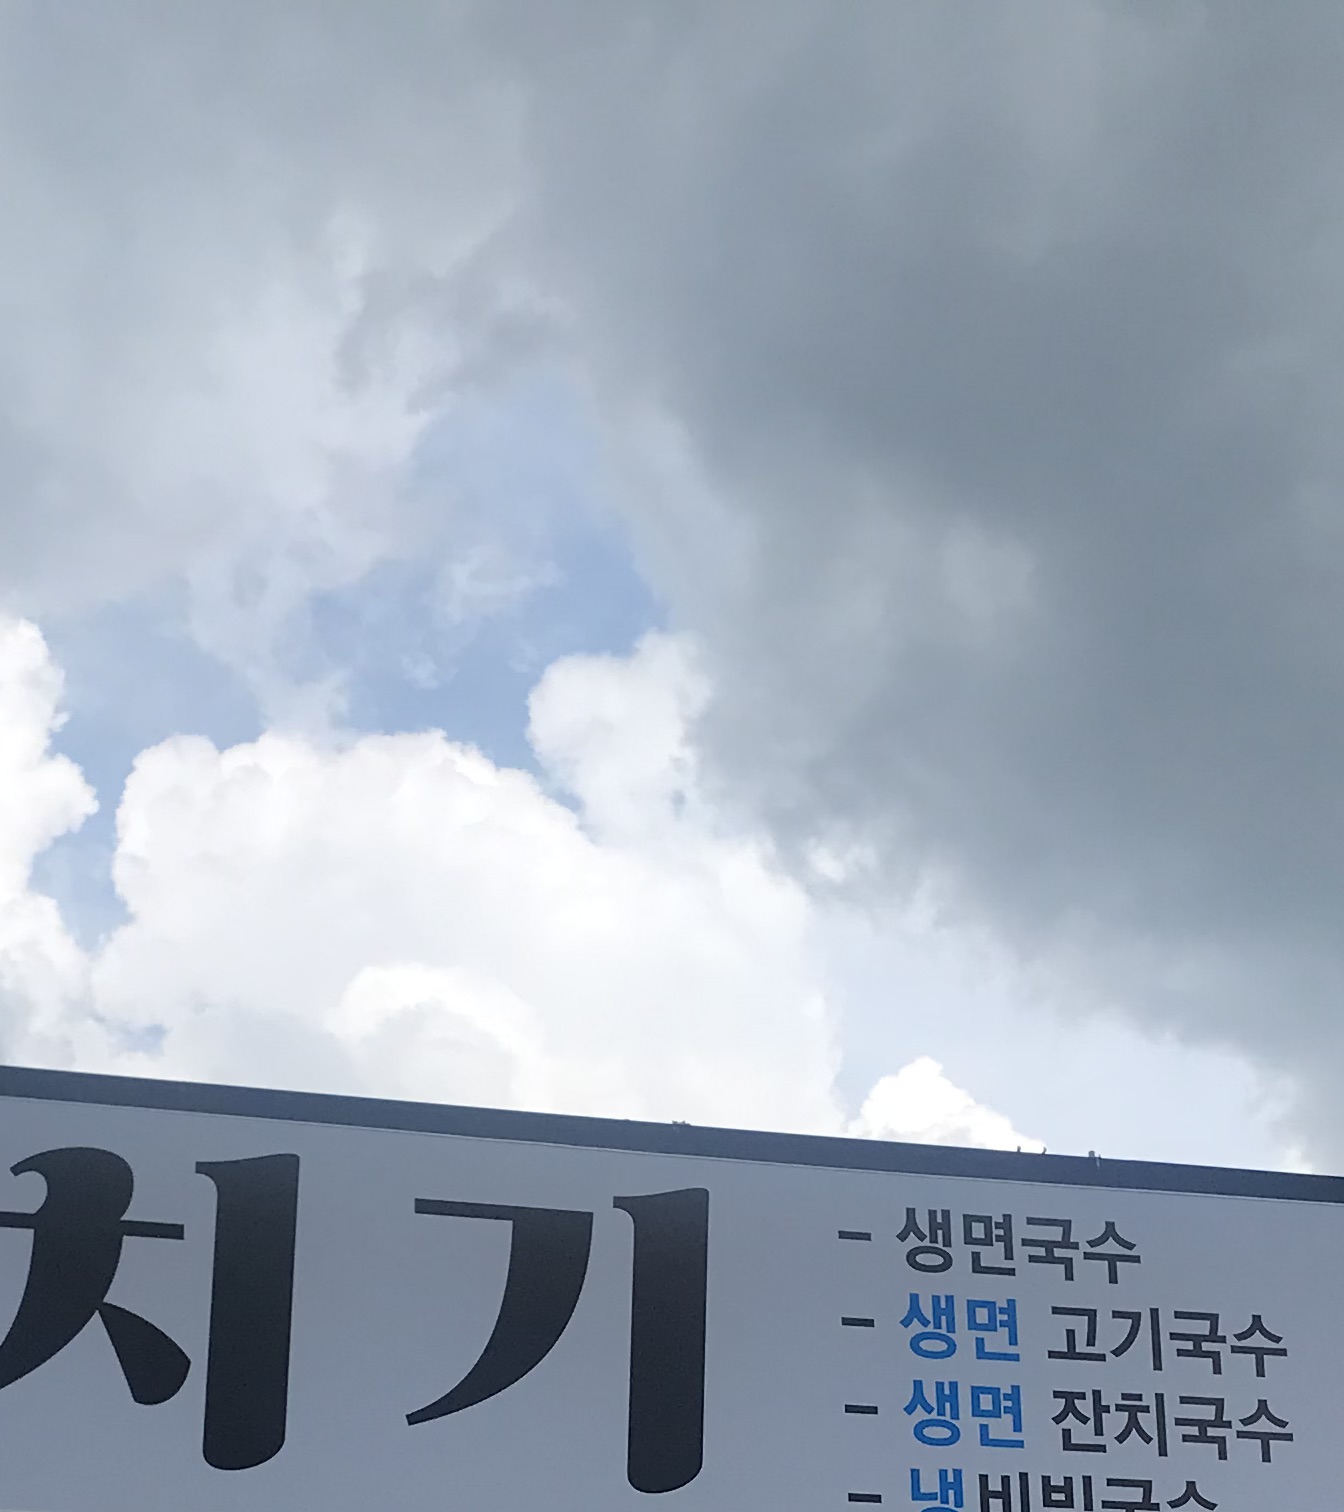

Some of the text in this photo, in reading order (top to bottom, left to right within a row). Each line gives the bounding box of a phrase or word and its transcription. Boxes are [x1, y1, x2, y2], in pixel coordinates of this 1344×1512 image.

[896, 1207, 1142, 1285] 생면국수
[899, 1292, 1288, 1378] 생면 고기국수
[903, 1378, 1294, 1464] 생면 잔치국수
